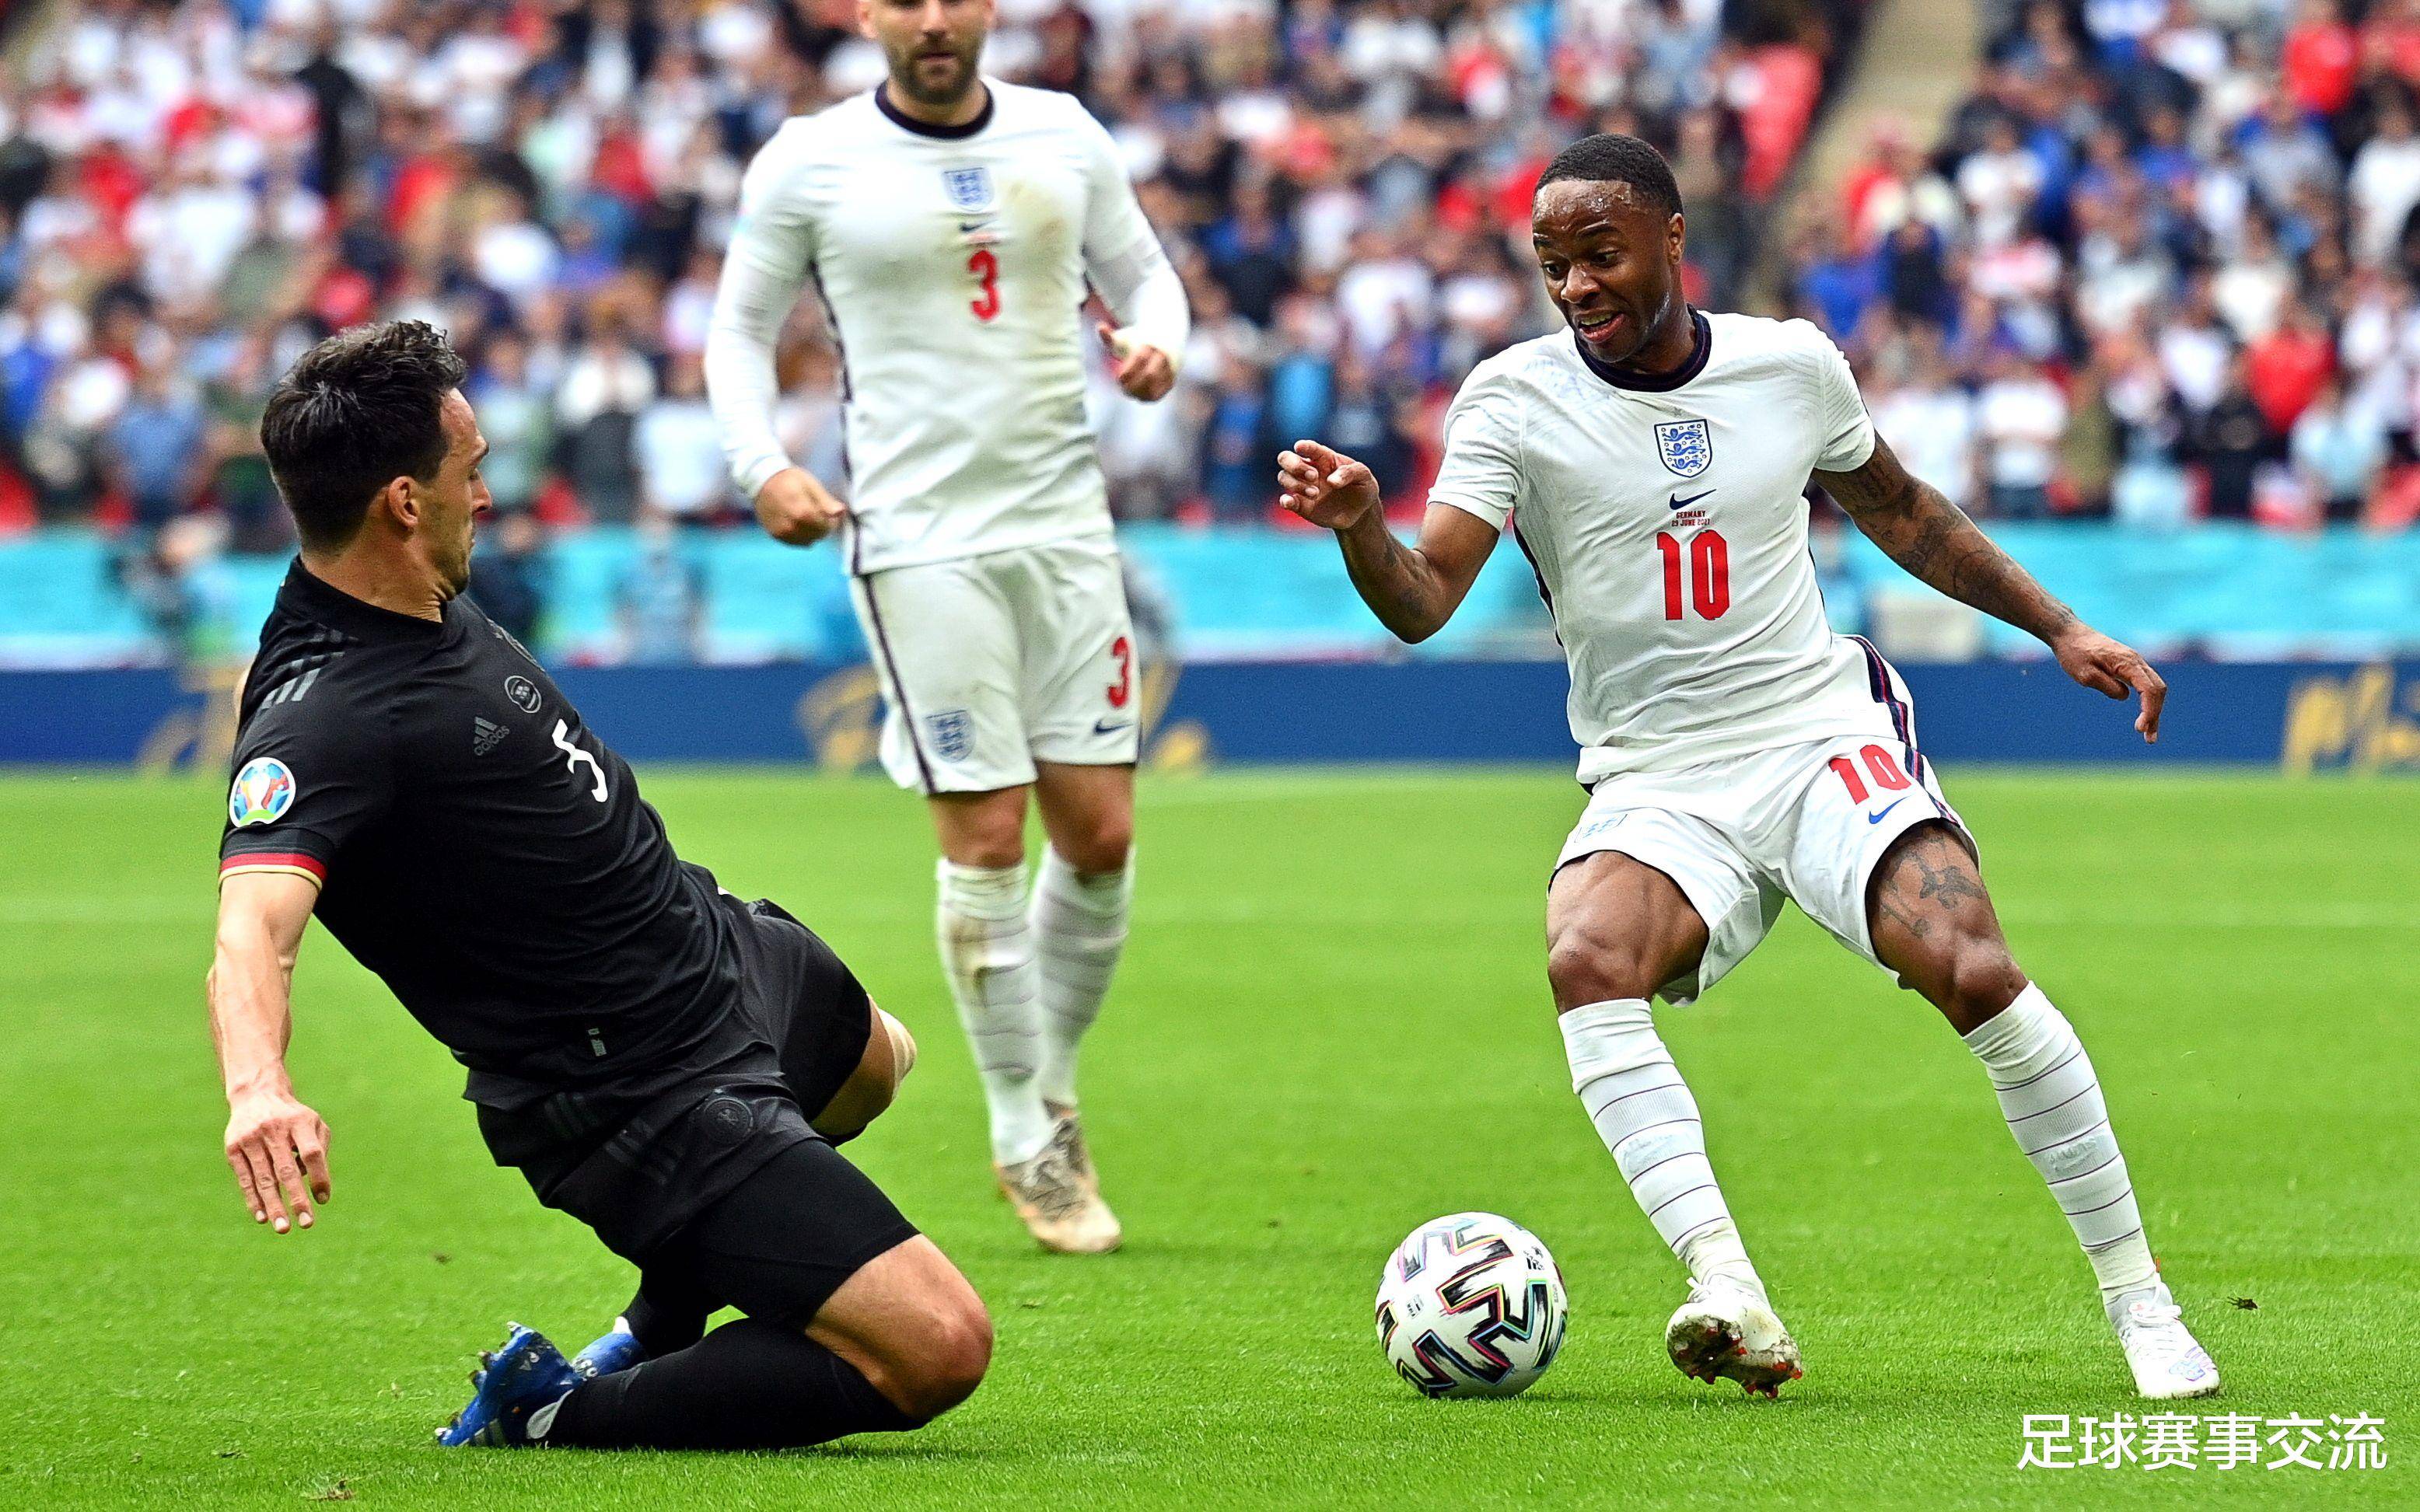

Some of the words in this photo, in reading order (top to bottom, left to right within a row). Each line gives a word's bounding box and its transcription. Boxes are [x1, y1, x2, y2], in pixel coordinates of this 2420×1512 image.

[968, 250, 1001, 321] 3
[1676, 510, 1706, 519] GERMANY
[1657, 529, 1729, 620] 10
[1107, 636, 1131, 708] 3
[551, 718, 608, 802] 5
[1828, 744, 1911, 805] 10
